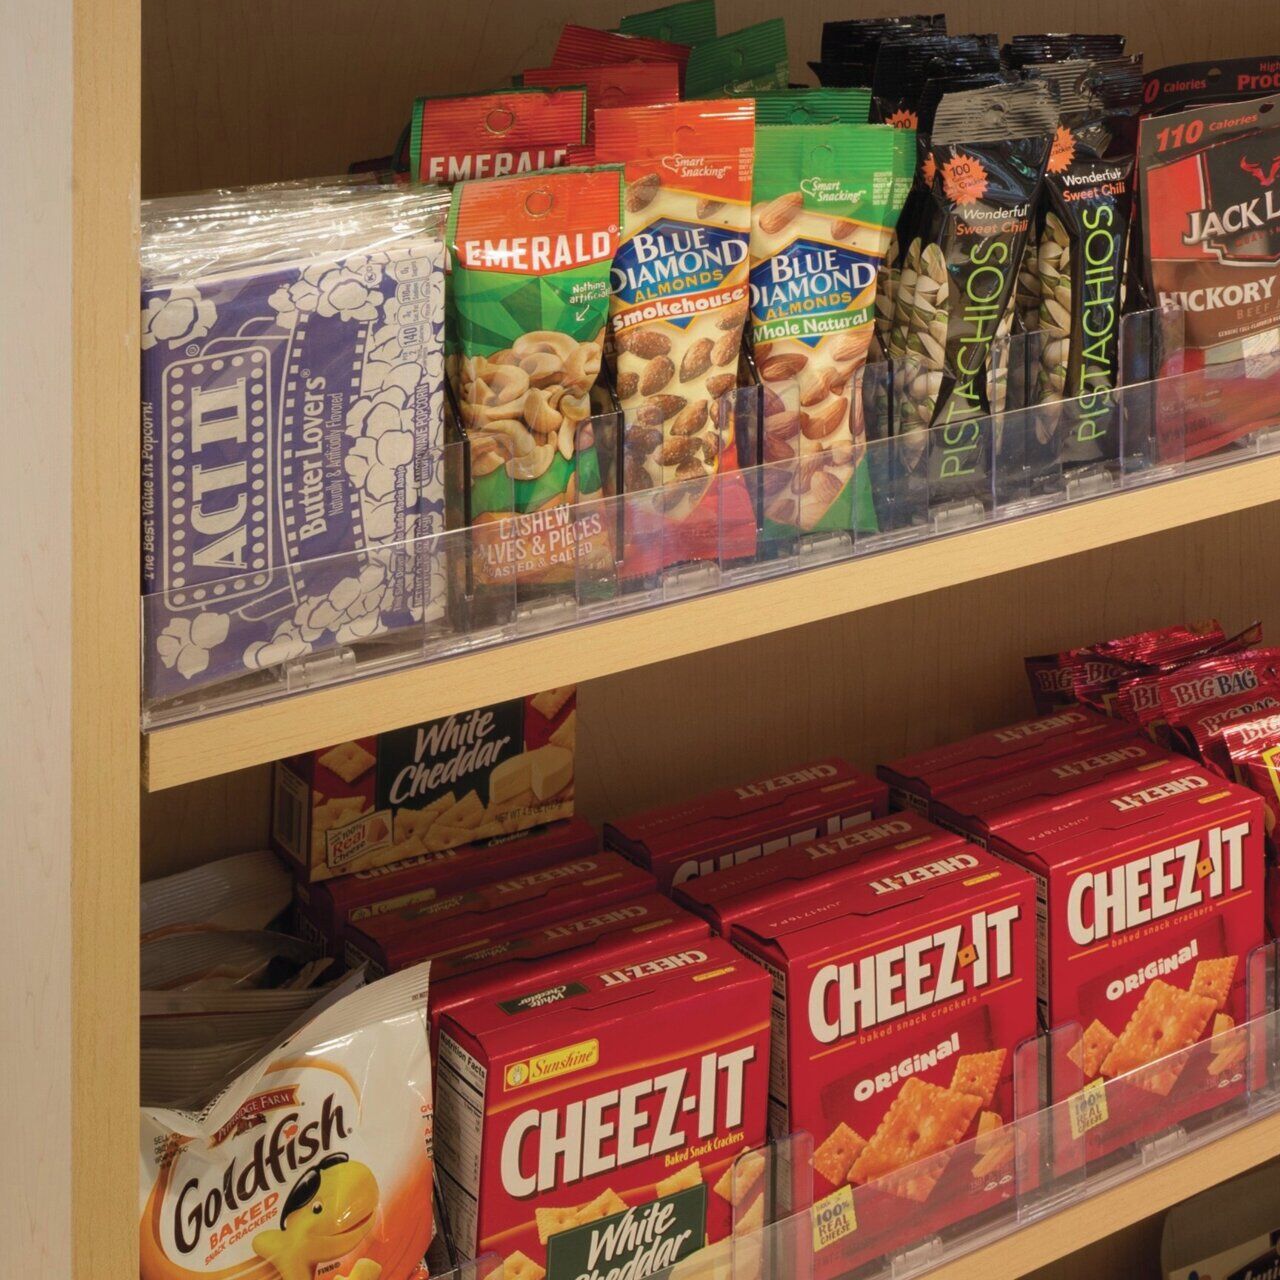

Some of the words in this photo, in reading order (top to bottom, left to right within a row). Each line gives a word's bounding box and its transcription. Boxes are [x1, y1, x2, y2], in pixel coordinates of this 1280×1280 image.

[1156, 119, 1204, 152] 110
[1209, 112, 1258, 132] Calories
[675, 157, 704, 168] Smart
[1062, 170, 1121, 187] Wonderful
[811, 180, 841, 191] Smart
[1063, 189, 1099, 203] Sweet
[1102, 179, 1126, 195] Chili
[957, 223, 998, 236] Sweet
[1001, 220, 1029, 234] Chili
[963, 204, 1029, 220] Wonderful
[1183, 196, 1264, 246] JACK
[465, 231, 611, 271] EMERALD
[633, 228, 711, 264] BLUE
[770, 249, 840, 283] BLUE
[609, 238, 749, 295] DIAMOND
[634, 270, 724, 303] ALMONDS
[750, 262, 877, 310] DIAMOND
[613, 289, 747, 332] Smokehouse
[765, 291, 852, 320] ALMONDS
[1158, 275, 1276, 314] HICKORY
[1237, 303, 1270, 320] BEEF
[807, 310, 868, 335] Natural
[1076, 205, 1114, 443] PISTACHIOS
[940, 240, 1008, 479] PISTACHIOS
[190, 376, 247, 453] II
[325, 392, 342, 428] Flavored
[142, 401, 158, 461] Popcorn!
[190, 464, 248, 569] ACT
[299, 460, 327, 540] Butter
[327, 479, 346, 516] Naturally
[500, 503, 570, 540] CASHEW
[550, 513, 602, 550] PIECES
[1172, 679, 1216, 708] BIG
[1218, 668, 1258, 698] BAG
[413, 708, 496, 763] White
[388, 735, 511, 806] Cheddar
[1111, 929, 1141, 948] baked
[1143, 919, 1171, 936] snack
[1173, 904, 1215, 930] crackers
[860, 1027, 893, 1045] baked
[896, 1014, 928, 1030] snack
[931, 995, 977, 1018] crackers
[532, 1048, 595, 1079] Sunshine
[499, 1045, 755, 1199] CHEEZ-IT
[664, 1151, 689, 1168] Baked
[689, 1142, 712, 1160] Snack
[712, 1131, 744, 1151] Crackers
[174, 1092, 348, 1254] Goldfish
[209, 1192, 280, 1251] BAKED
[227, 1207, 279, 1245] CRACKERS
[587, 1202, 676, 1270] White
